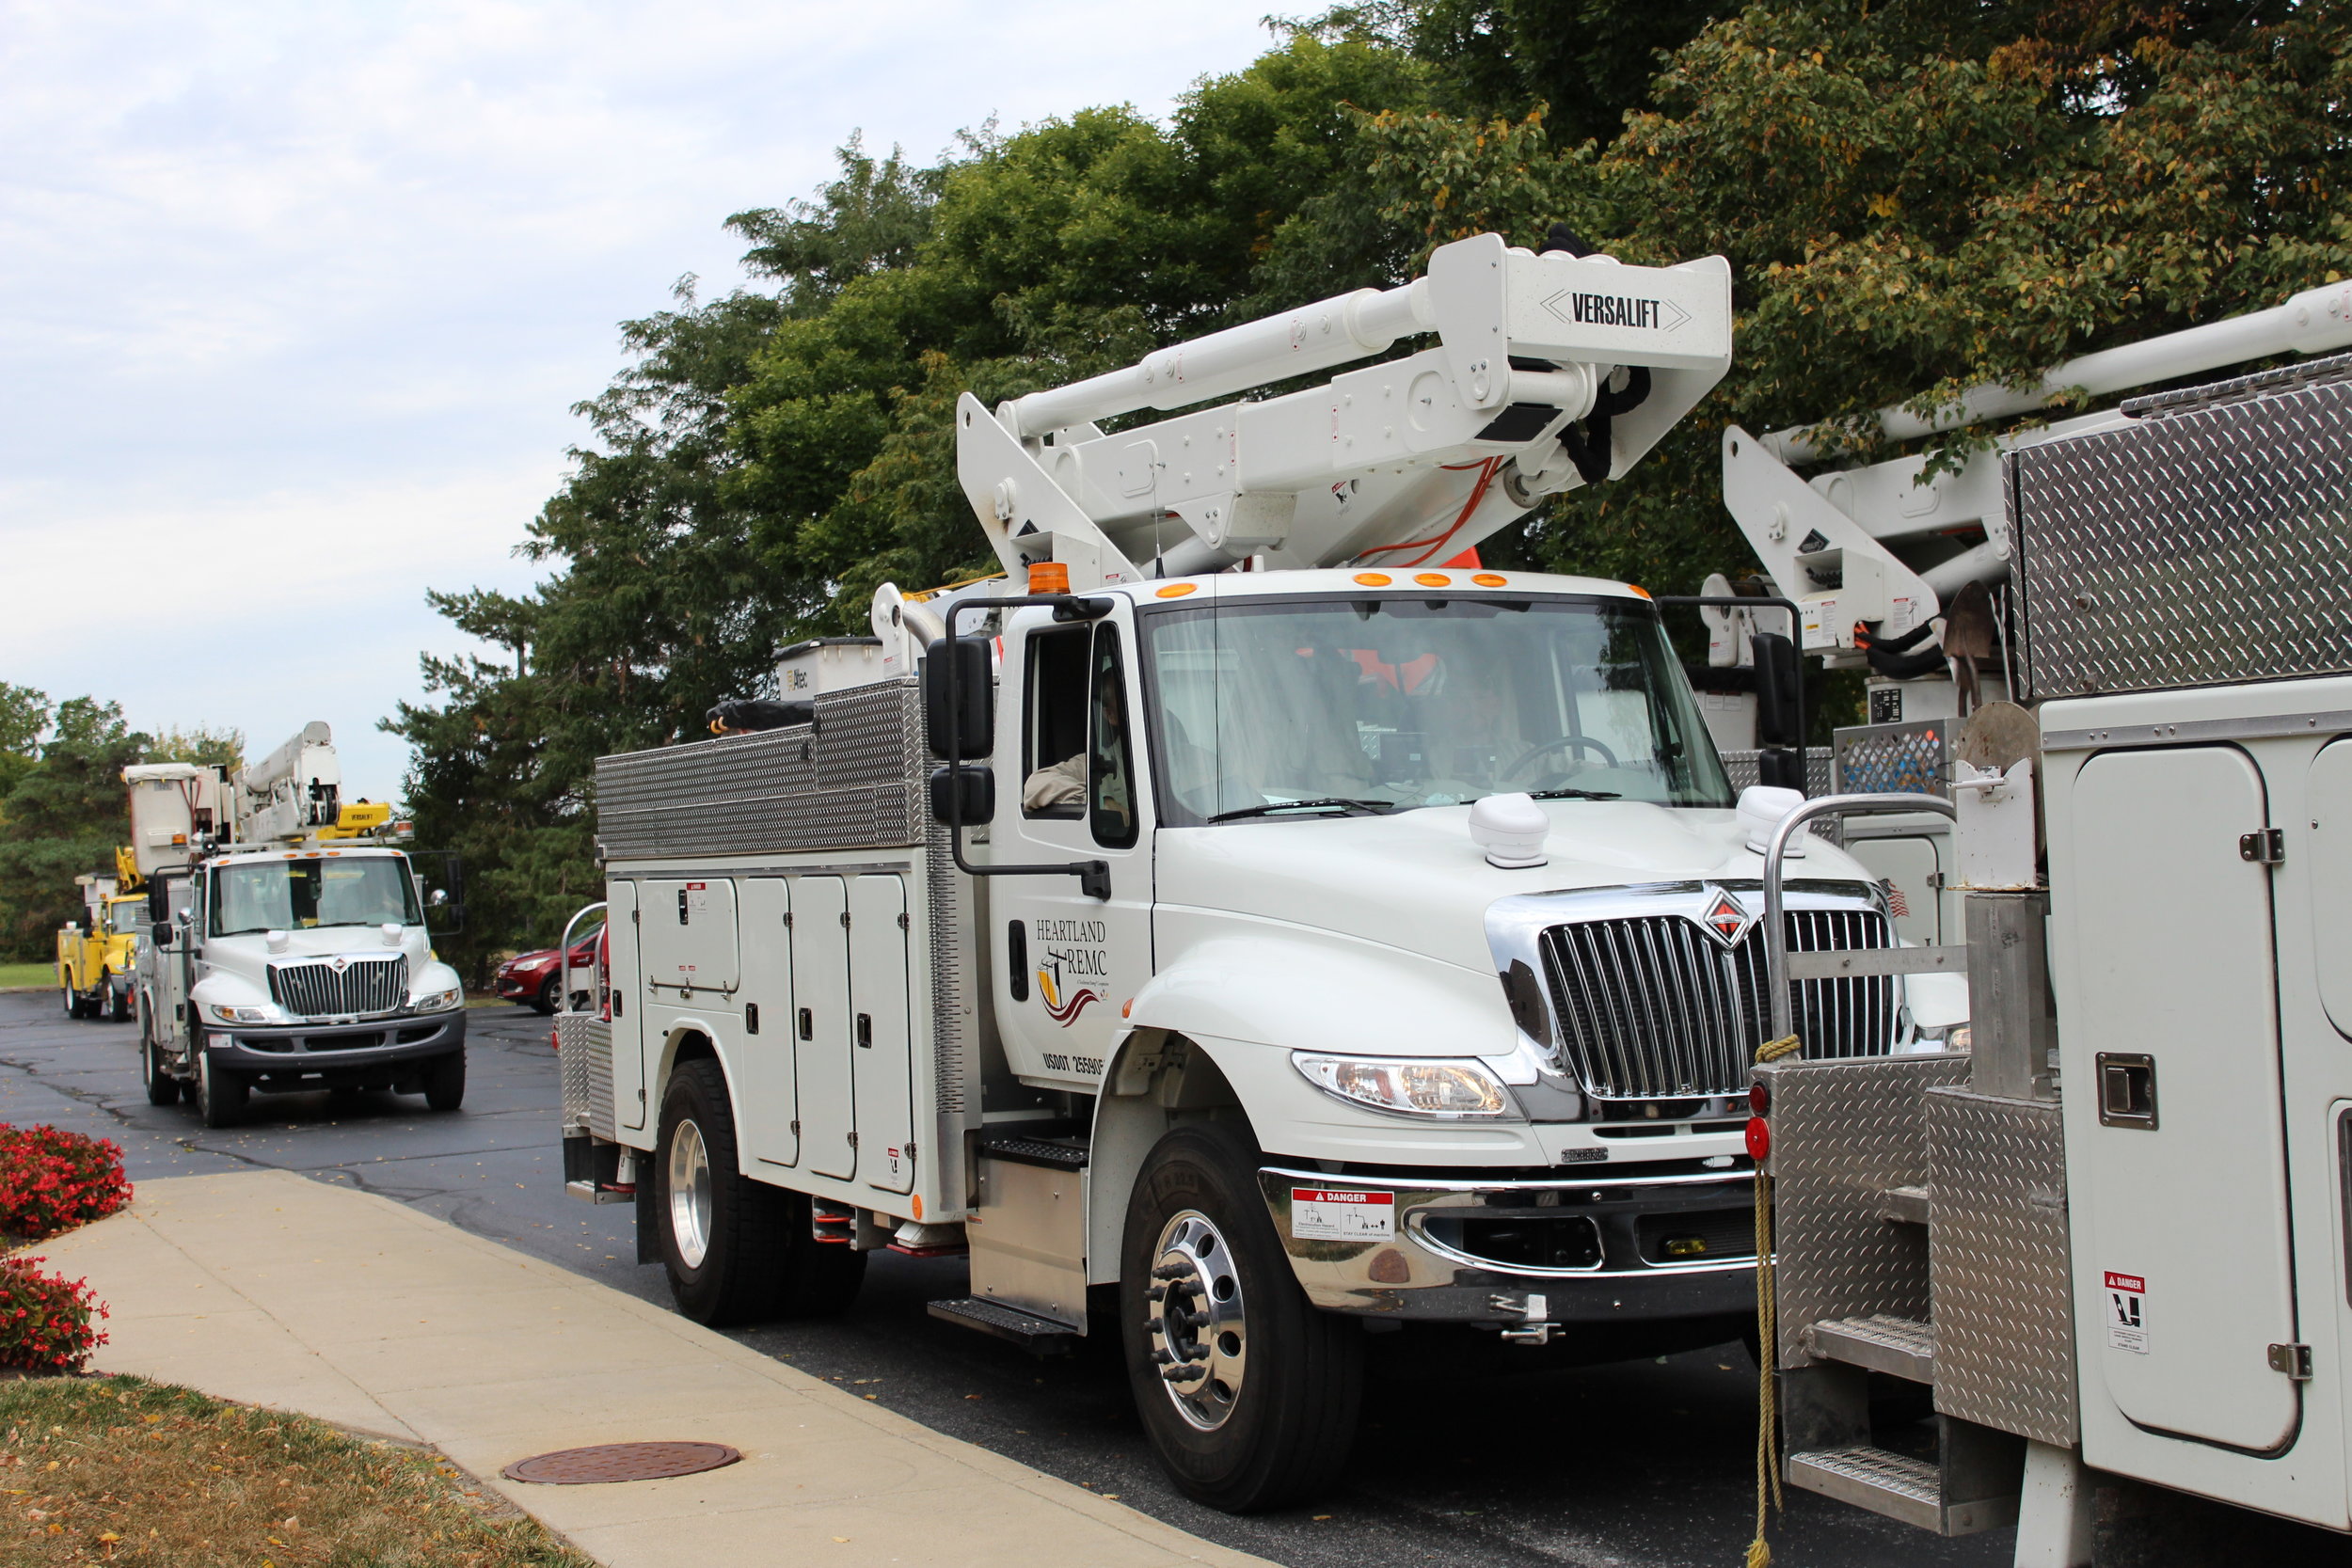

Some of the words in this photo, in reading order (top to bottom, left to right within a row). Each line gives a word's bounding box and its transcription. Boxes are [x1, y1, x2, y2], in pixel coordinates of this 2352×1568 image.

[1572, 292, 1660, 329] VERSALIFT
[1037, 919, 1106, 942] HEARTLAND
[1066, 948, 1108, 976] REMC
[1042, 1053, 1071, 1072] USDOT
[1073, 1055, 1105, 1075] 255905
[1327, 1193, 1367, 1203] DANGER
[2117, 1276, 2142, 1290] DANGER
